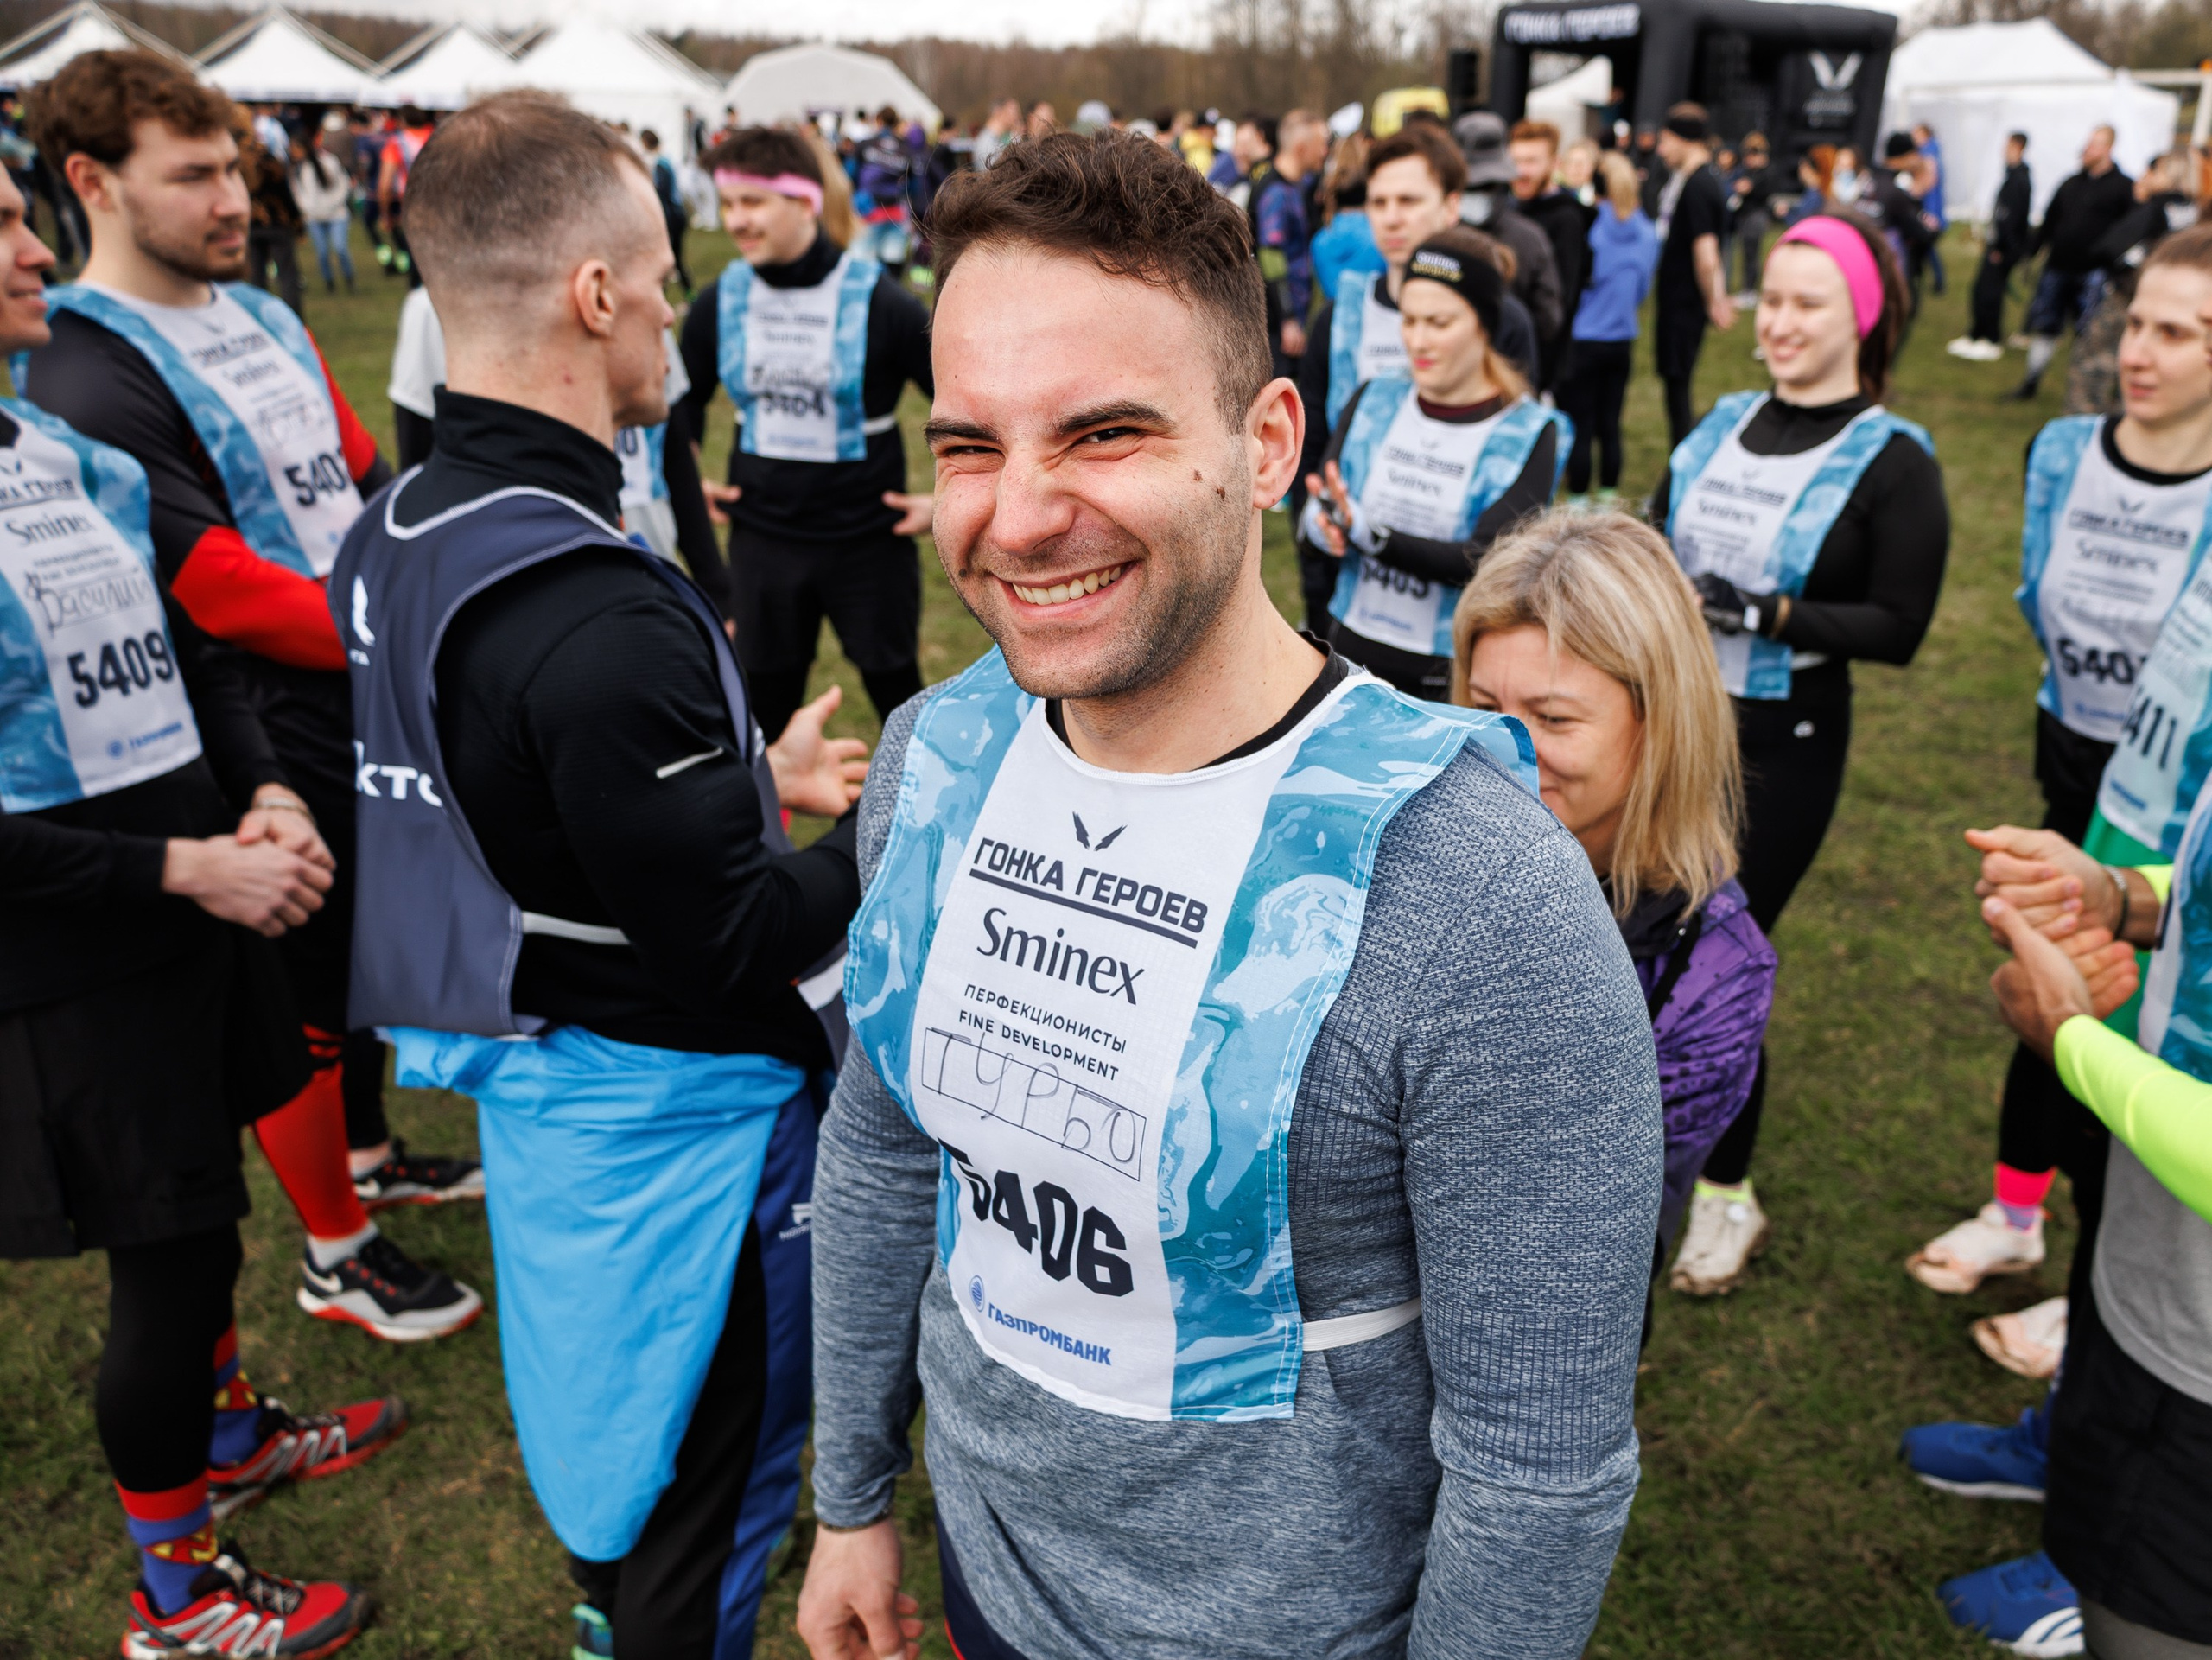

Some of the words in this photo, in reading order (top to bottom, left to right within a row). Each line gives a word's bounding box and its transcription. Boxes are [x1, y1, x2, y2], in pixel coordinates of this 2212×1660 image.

[67, 629, 175, 709] 5409
[974, 837, 1065, 892] ГОНКА
[1075, 868, 1209, 934] ГЕРОЕВ
[976, 907, 1145, 1006] Sminex
[958, 1009, 995, 1034] FINE
[1001, 1024, 1120, 1081] DEVELOPMENT
[964, 983, 1127, 1054] ПЕРФЕКЦИОНИСТЫ
[936, 1136, 1135, 1298] 5406
[987, 1302, 1113, 1366] ГАЗПРОМБАНК
